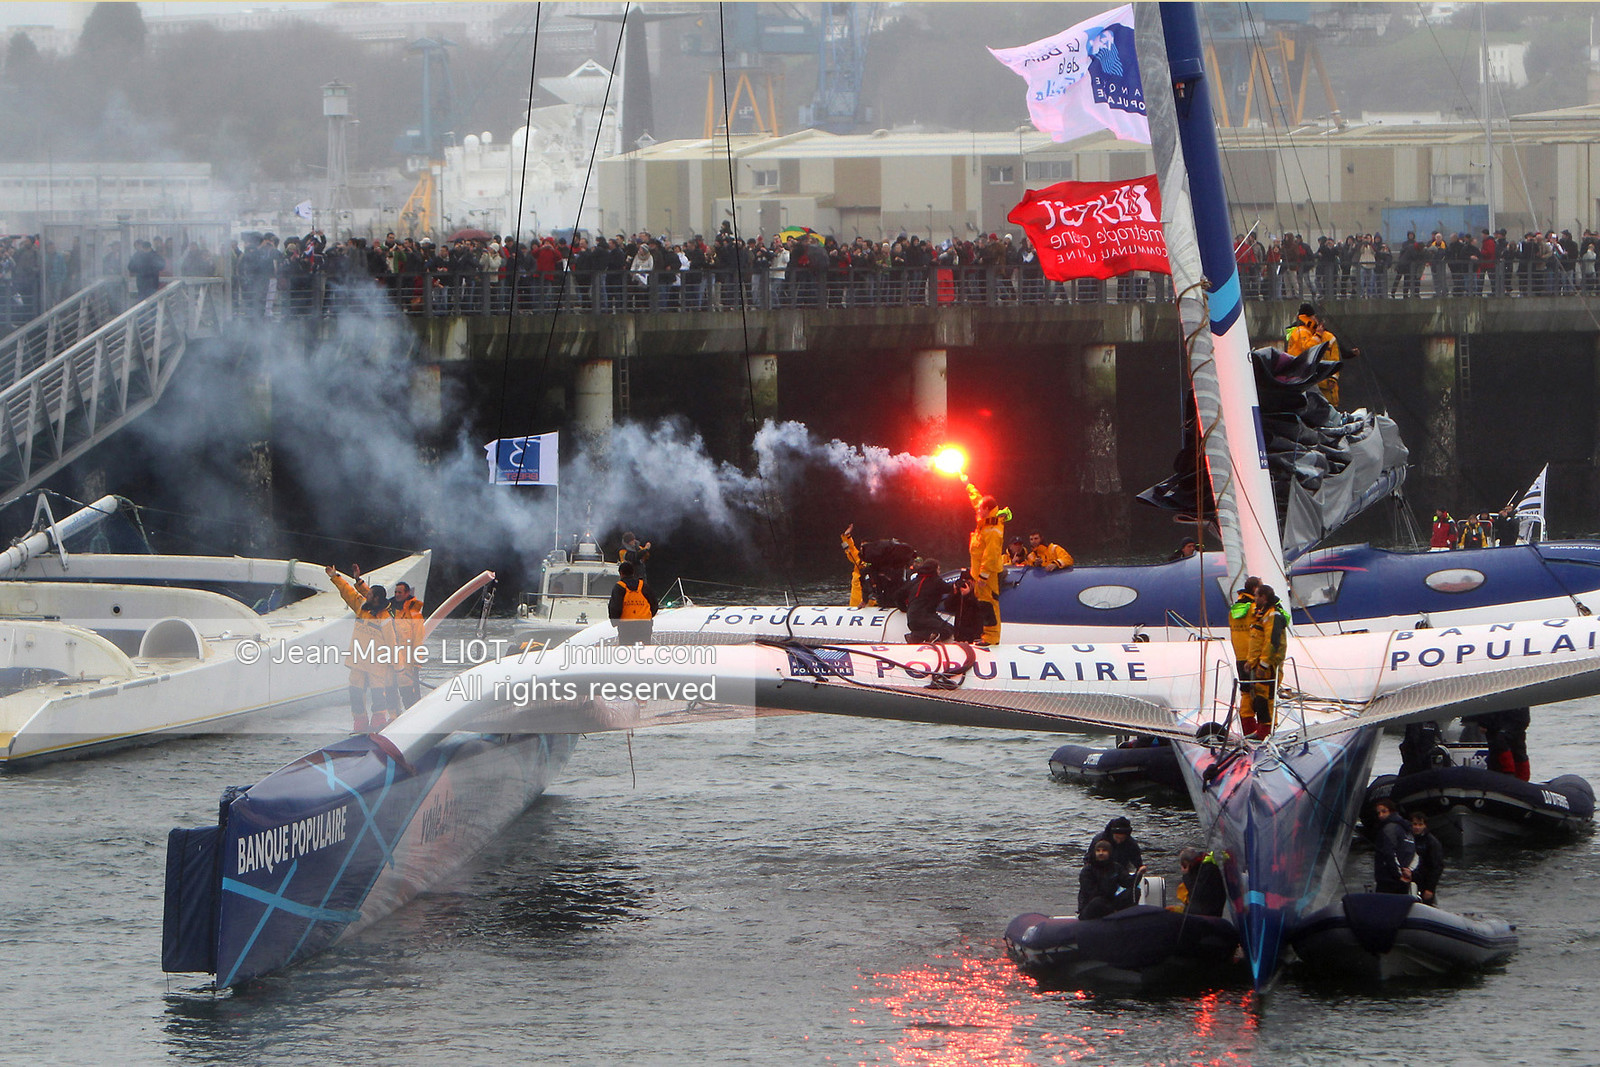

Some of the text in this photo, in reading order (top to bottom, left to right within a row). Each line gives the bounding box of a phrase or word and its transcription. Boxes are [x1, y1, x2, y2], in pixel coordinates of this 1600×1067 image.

[706, 614, 886, 627] POPULAIRE
[1395, 614, 1600, 641] BANQ
[237, 805, 347, 875] BANQUE POPULAIRE
